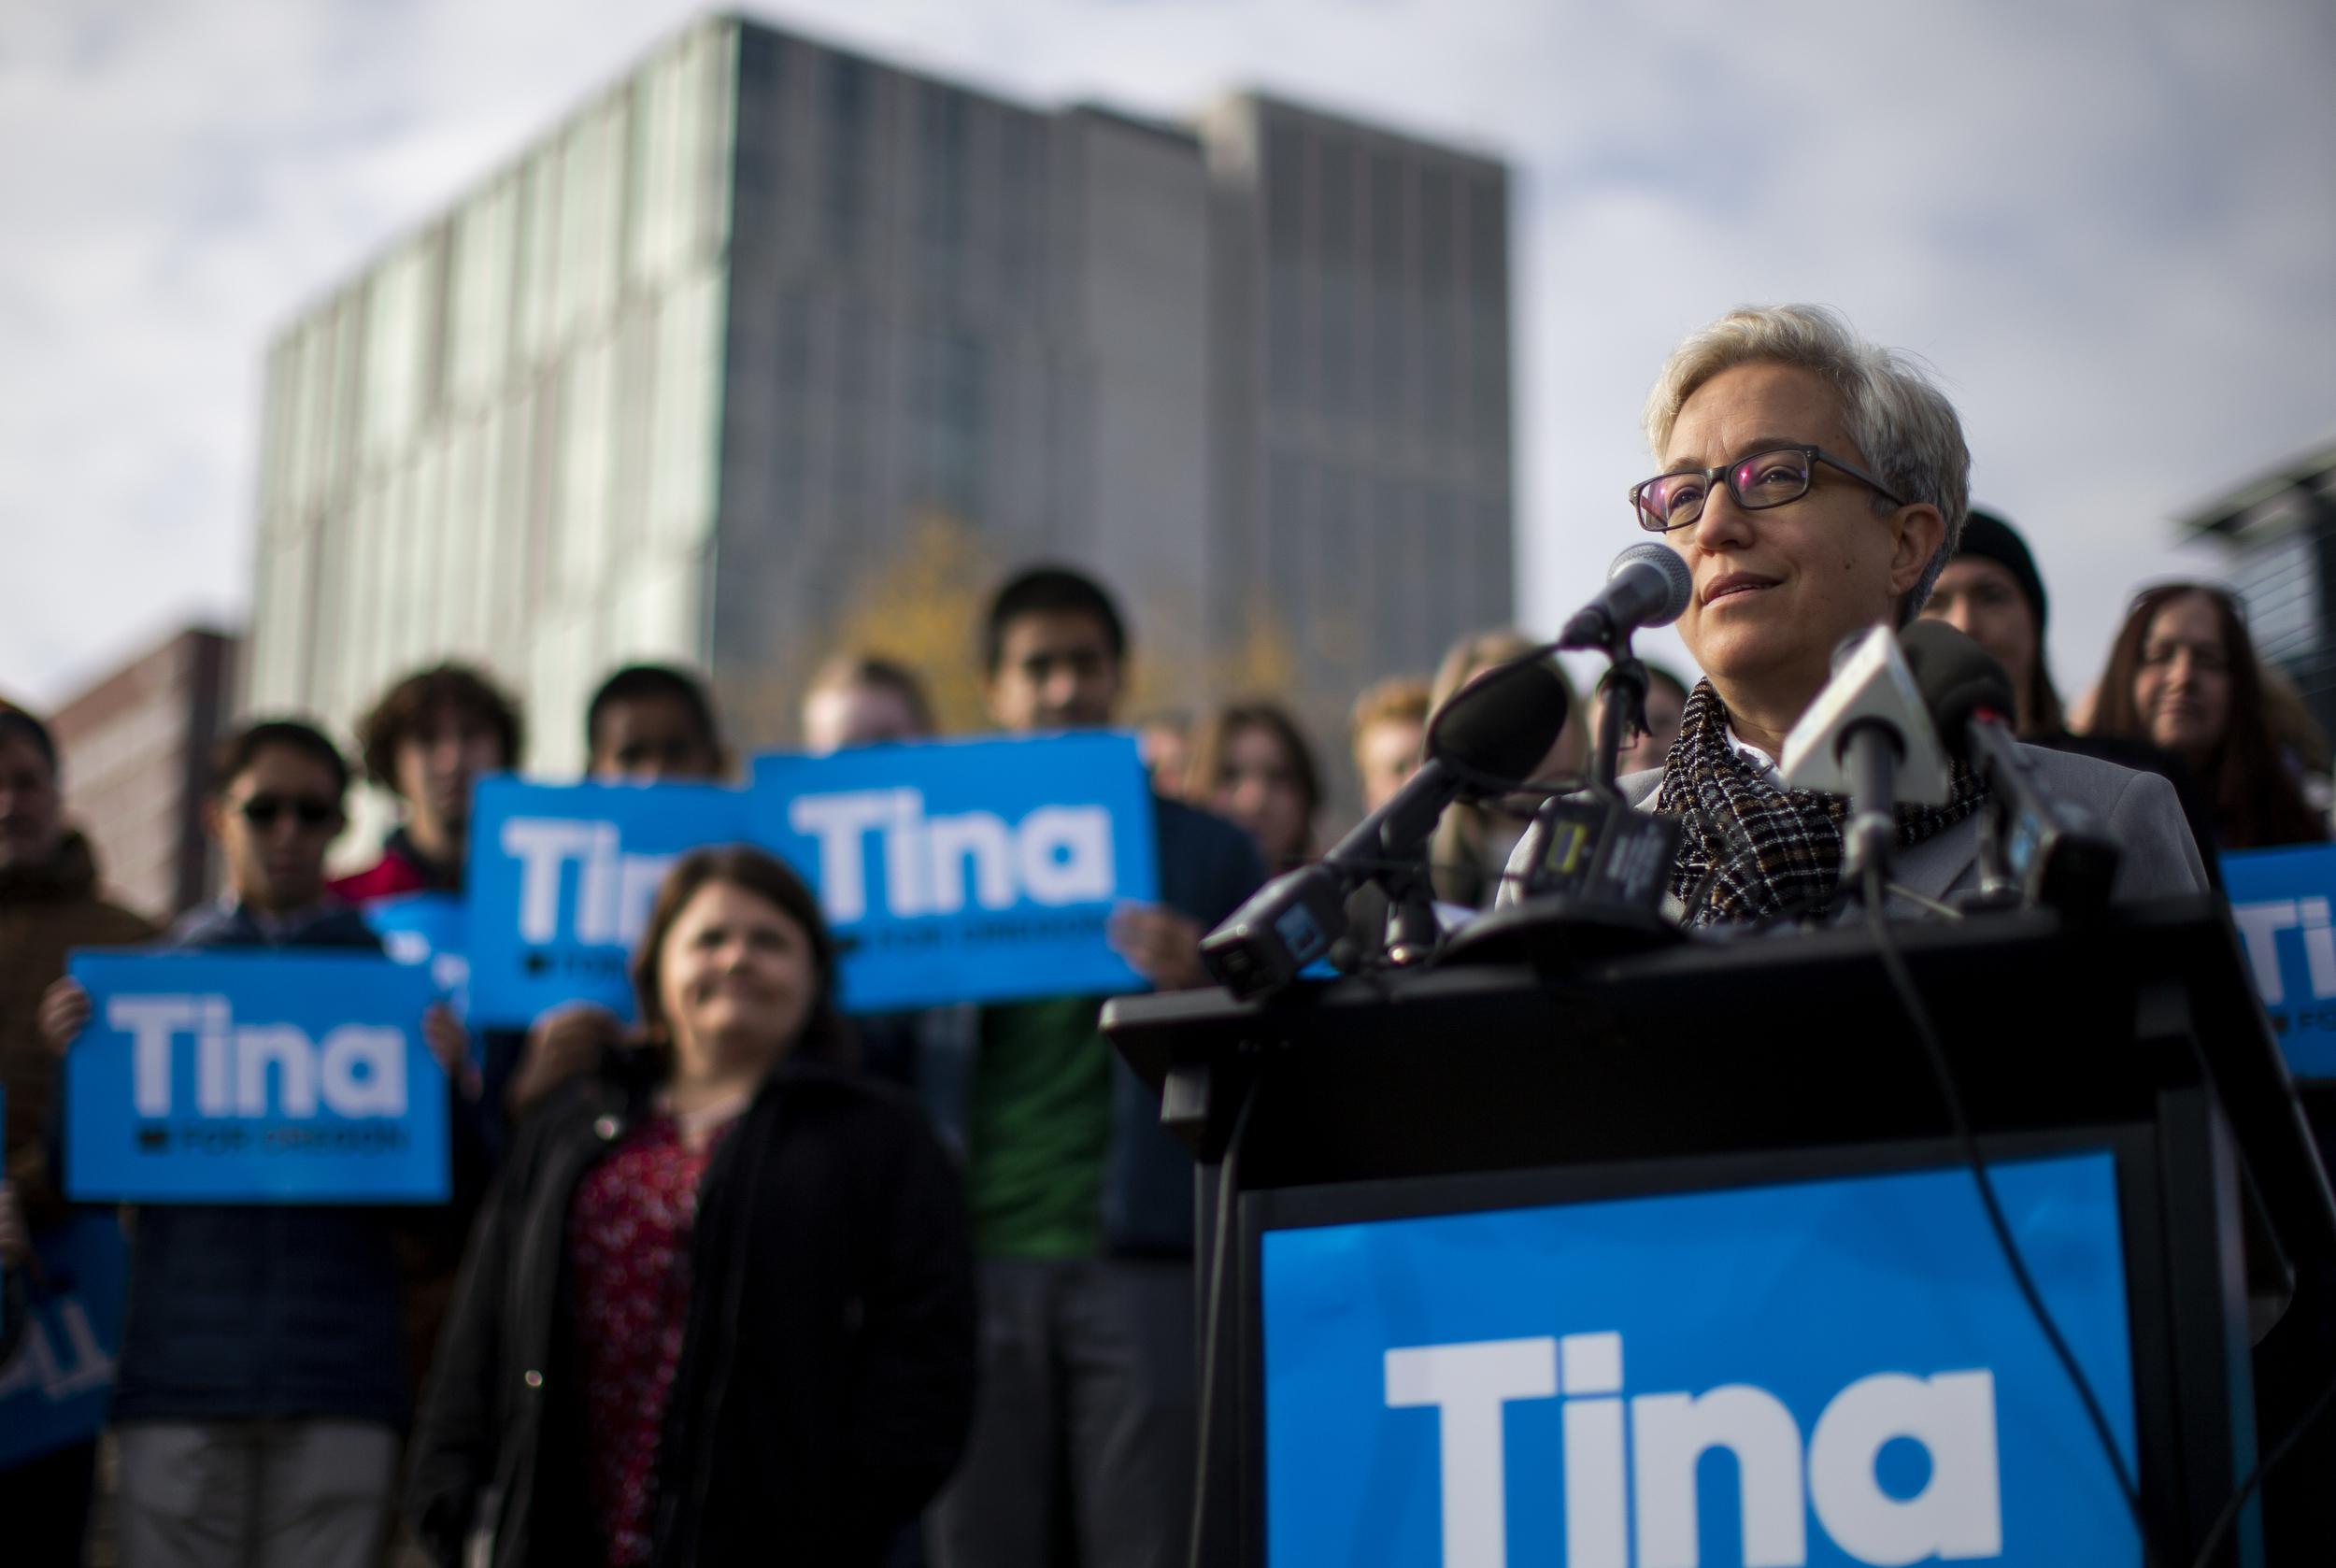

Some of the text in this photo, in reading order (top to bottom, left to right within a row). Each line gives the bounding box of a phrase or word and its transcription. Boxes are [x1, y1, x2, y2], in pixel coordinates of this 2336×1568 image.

[788, 786, 1116, 923] Tina
[107, 993, 408, 1118] Tina
[1384, 1331, 2002, 1568] Tina
